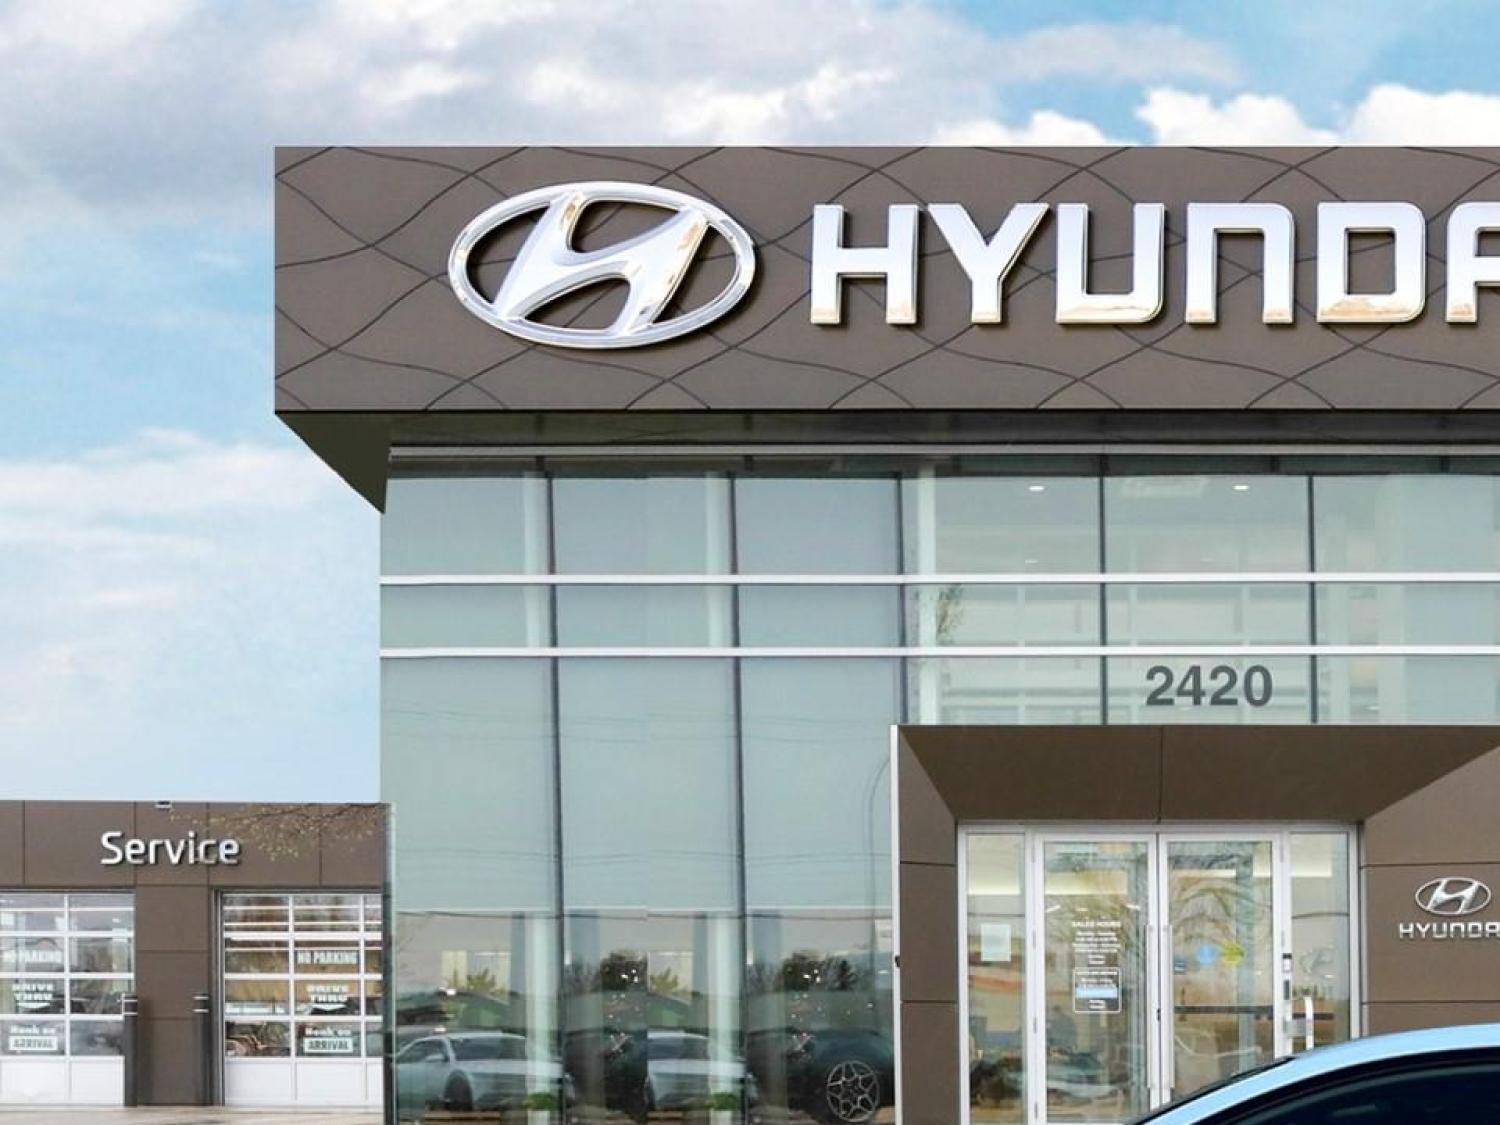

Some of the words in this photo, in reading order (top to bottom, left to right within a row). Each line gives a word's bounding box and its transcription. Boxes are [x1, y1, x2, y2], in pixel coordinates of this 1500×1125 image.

[1146, 665, 1272, 706] 2420
[100, 830, 240, 865] Service
[313, 951, 357, 964] PARKING
[309, 1039, 349, 1050] ARRIVAL
